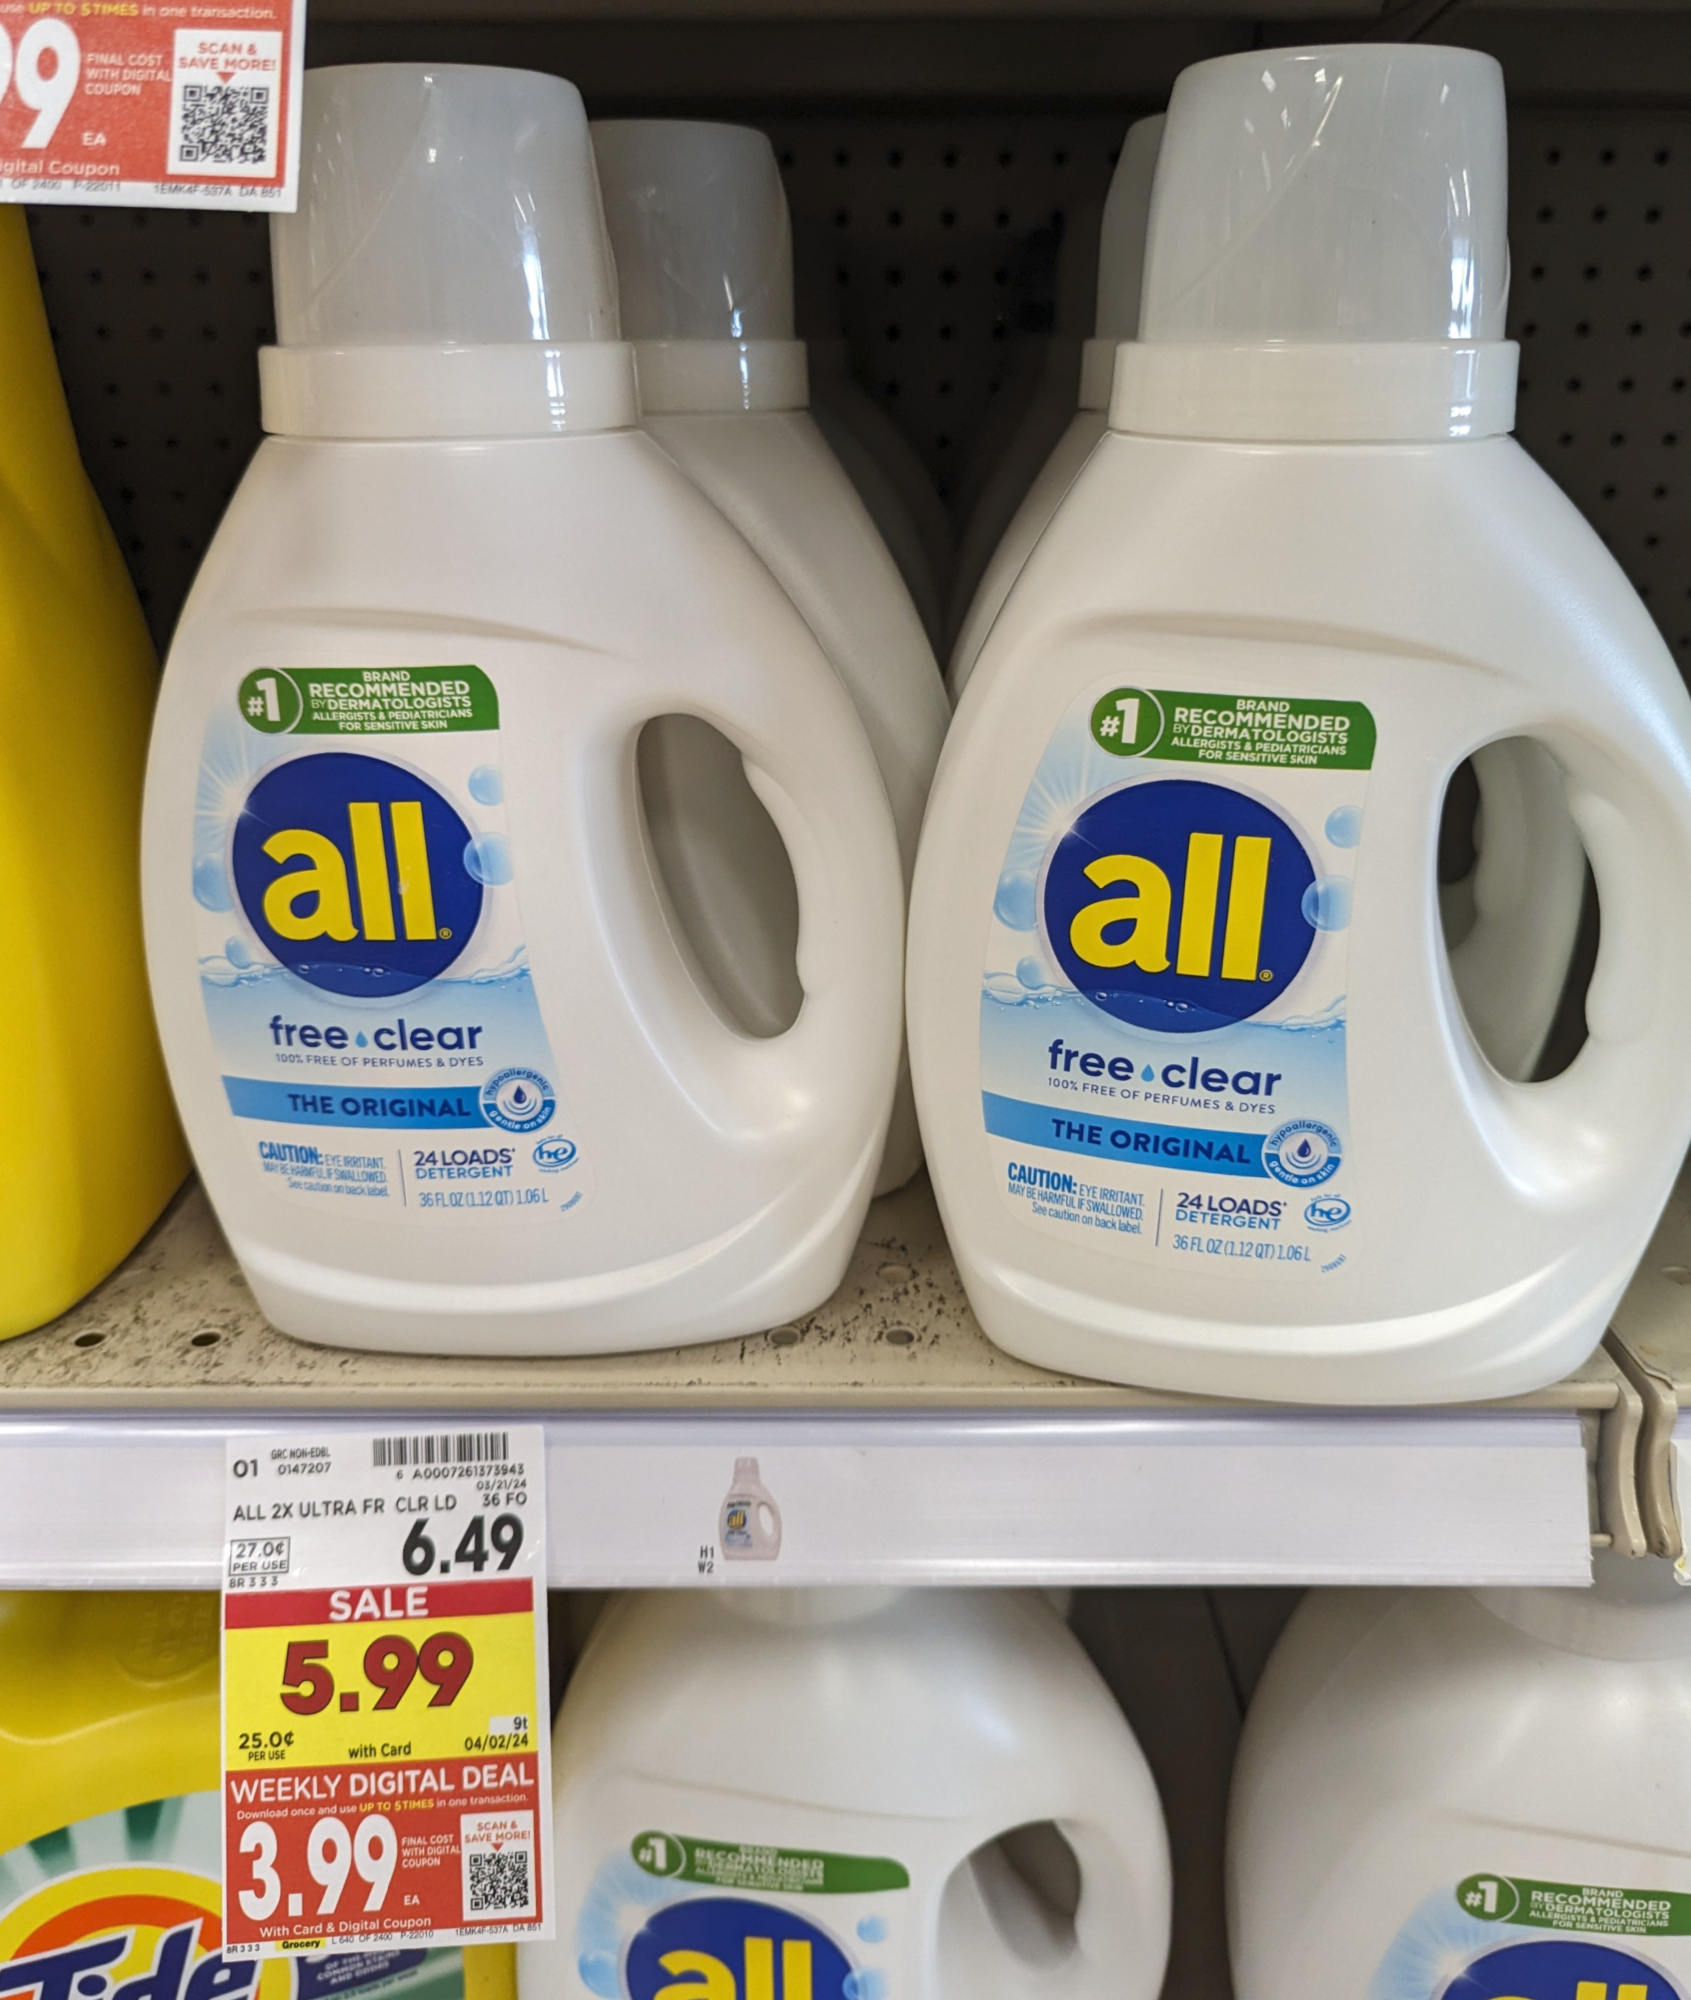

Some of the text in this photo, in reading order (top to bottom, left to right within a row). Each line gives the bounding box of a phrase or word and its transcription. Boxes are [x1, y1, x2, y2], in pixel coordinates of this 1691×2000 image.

[28, 2, 49, 15] UP
[54, 2, 75, 15] TO
[142, 6, 154, 16] in
[159, 8, 186, 17] one
[197, 43, 257, 55] SCAN &
[86, 55, 163, 67] FINAL COST
[179, 58, 276, 71] SAVE MORE!
[86, 69, 172, 82] WITH DIGITAL
[85, 83, 140, 95] COUPON
[82, 132, 106, 147] EA
[0, 161, 120, 177] igital Coupon
[363, 671, 411, 682] BRAND
[309, 681, 470, 698] RECOMMENDED
[247, 677, 281, 722] #1
[327, 695, 472, 711] DERMATOLOGISTS
[1236, 699, 1290, 713] BRAND
[313, 709, 473, 721] ALLERGISTS PEDIATRICIANS
[1100, 698, 1140, 744] #1
[1174, 707, 1350, 732] RECOMMENDED
[340, 718, 447, 731] FOR SENSITIVE SKIN
[1190, 725, 1348, 745] DERMATOLOGISTS
[1171, 737, 1347, 756] ALLERGISTS PEDIATRICIANS
[1198, 749, 1318, 765] FOR SENSITIVE SKIN
[262, 801, 437, 942] all
[1069, 831, 1272, 981] all
[270, 1015, 482, 1051] free clear
[276, 1054, 484, 1068] 100% FREE OF PERFUMES & DYES
[1048, 1039, 1282, 1096] free clear
[1048, 1077, 1275, 1115] 100% FREE OF PERFUMES & DYES
[288, 1093, 471, 1117] THE ORIGINAL
[1052, 1118, 1251, 1164] THE ORIGINAL
[1269, 1120, 1337, 1148] hypoallergenic
[259, 1141, 324, 1166] CAUTION:
[415, 1150, 440, 1166] 24
[416, 1165, 513, 1180] DETERGENT
[1008, 1162, 1145, 1207] CAUTION: EYE IRRITANT.
[1177, 1192, 1203, 1211] 24
[1047, 1205, 1080, 1222] caution
[1176, 1209, 1281, 1231] DETERGENT
[1172, 1234, 1302, 1261] 36 FL OZ 1.06
[271, 1447, 331, 1459] GRC NON-EDBL
[278, 1462, 331, 1475] 0147207
[413, 1463, 525, 1480] A0007261373943
[477, 1479, 527, 1491] 03/21/24
[233, 1494, 457, 1521] ALL 2X ULTRA FR CLR LD
[483, 1492, 527, 1507] 36 FO
[402, 1512, 524, 1576] 6.49
[233, 1559, 287, 1572] PER USE
[698, 1561, 714, 1574] W2
[330, 1587, 429, 1620] SALE
[280, 1632, 474, 1715] 5.99
[239, 1731, 294, 1750] 25.0¢
[464, 1734, 529, 1751] 04/02/24
[249, 1750, 286, 1762] PER USE
[349, 1742, 411, 1758] with Card
[231, 1762, 535, 1804] WEEKLY DIGITAL DEAL
[237, 1809, 288, 1820] Download
[291, 1808, 316, 1817] once
[319, 1804, 338, 1815] and
[340, 1805, 357, 1814] use
[360, 1803, 376, 1812] UP
[377, 1802, 392, 1811] TO
[437, 1799, 447, 1808] in
[449, 1799, 467, 1807] one
[470, 1794, 528, 1805] transaction.
[477, 1821, 517, 1832] SCAN &
[402, 1834, 454, 1846] FINAL COST
[464, 1831, 531, 1843] SAVE MORE!
[402, 1845, 460, 1856] WITH DIGITAL
[238, 1813, 398, 1921] 3.99
[402, 1857, 441, 1868] COUPON
[404, 1895, 420, 1906] EA
[1465, 1881, 1498, 1914] #1
[1582, 1887, 1624, 1898] BRAND
[1531, 1891, 1671, 1912] RECOMMENDED
[1529, 1910, 1669, 1928] ALLERGISTS PEDIATRICIANS
[1545, 1902, 1670, 1920] DERMATOLOGISTS
[259, 1917, 431, 1938] With Card & Digital Coupon
[1553, 1920, 1647, 1934] FOR SENSITIVE SKIN
[282, 1940, 321, 1950] Grocery
